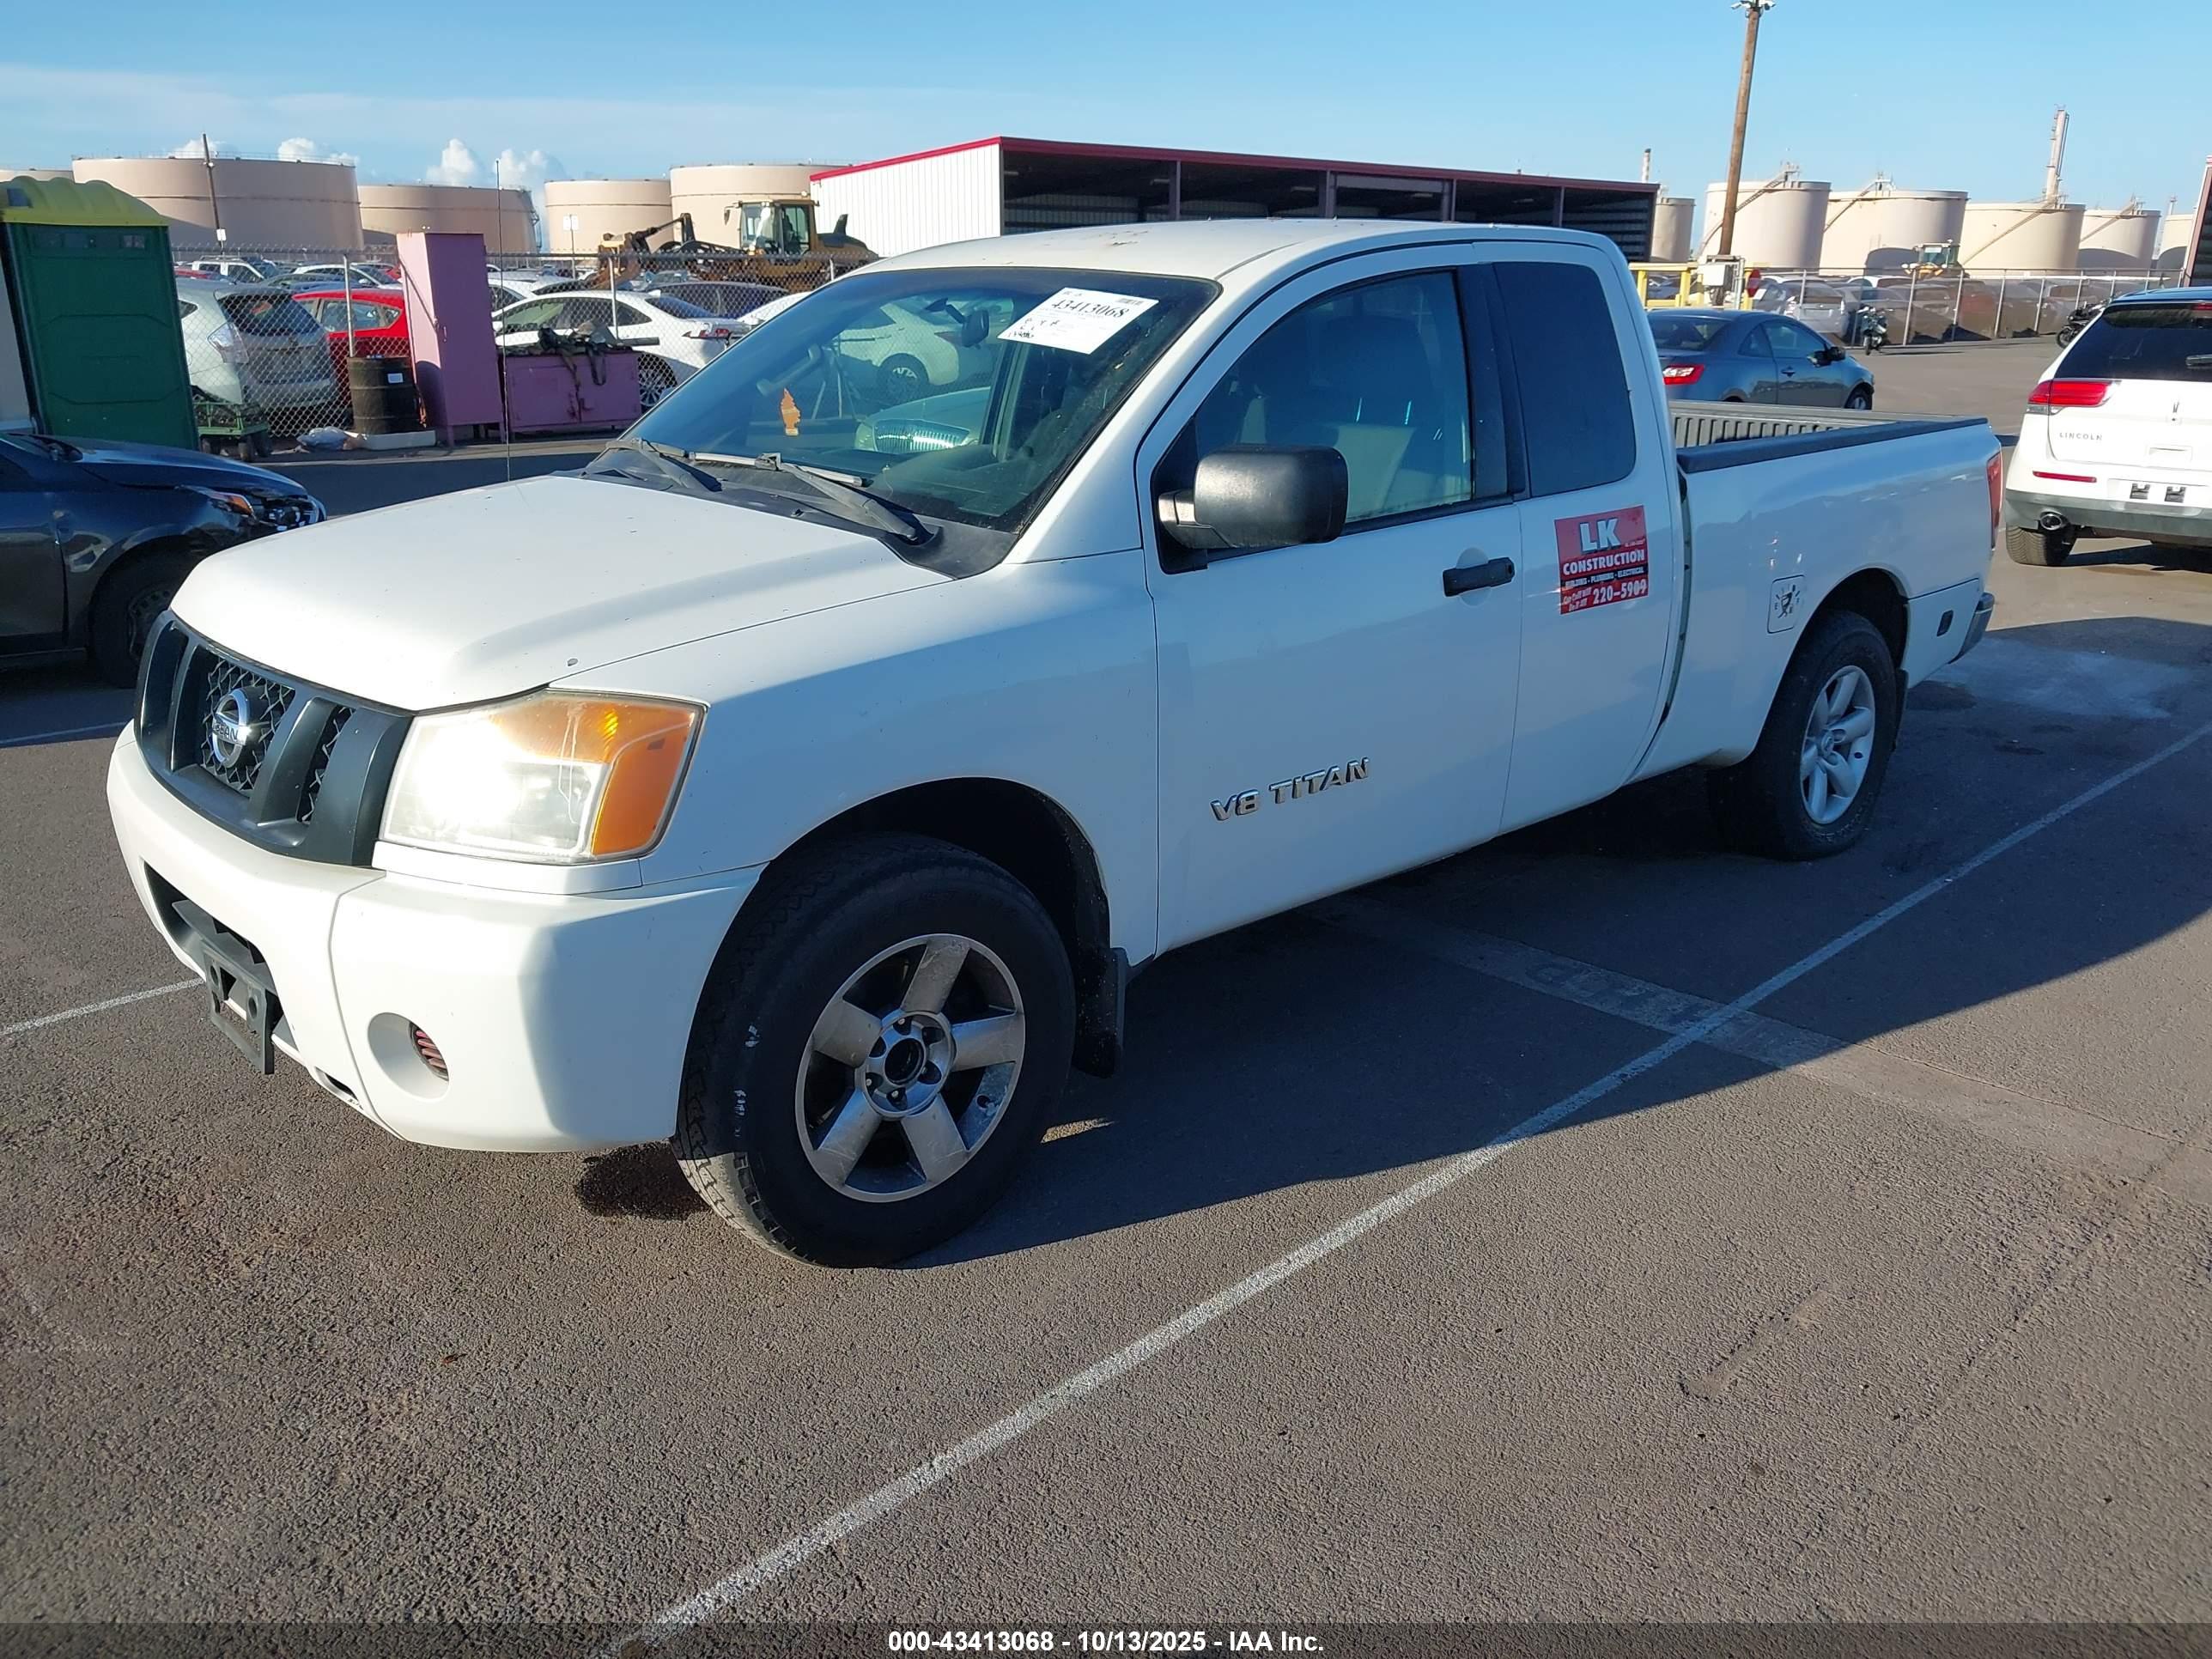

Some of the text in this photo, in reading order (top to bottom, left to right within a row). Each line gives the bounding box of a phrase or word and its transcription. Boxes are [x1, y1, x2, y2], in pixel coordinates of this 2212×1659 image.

[1051, 298, 1130, 318] 43413068
[2059, 431, 2103, 441] LINCOLN
[1579, 518, 1620, 552] LK
[1563, 549, 1645, 575] CONSTRUCTION
[1210, 757, 1370, 821] V8 TITAN
